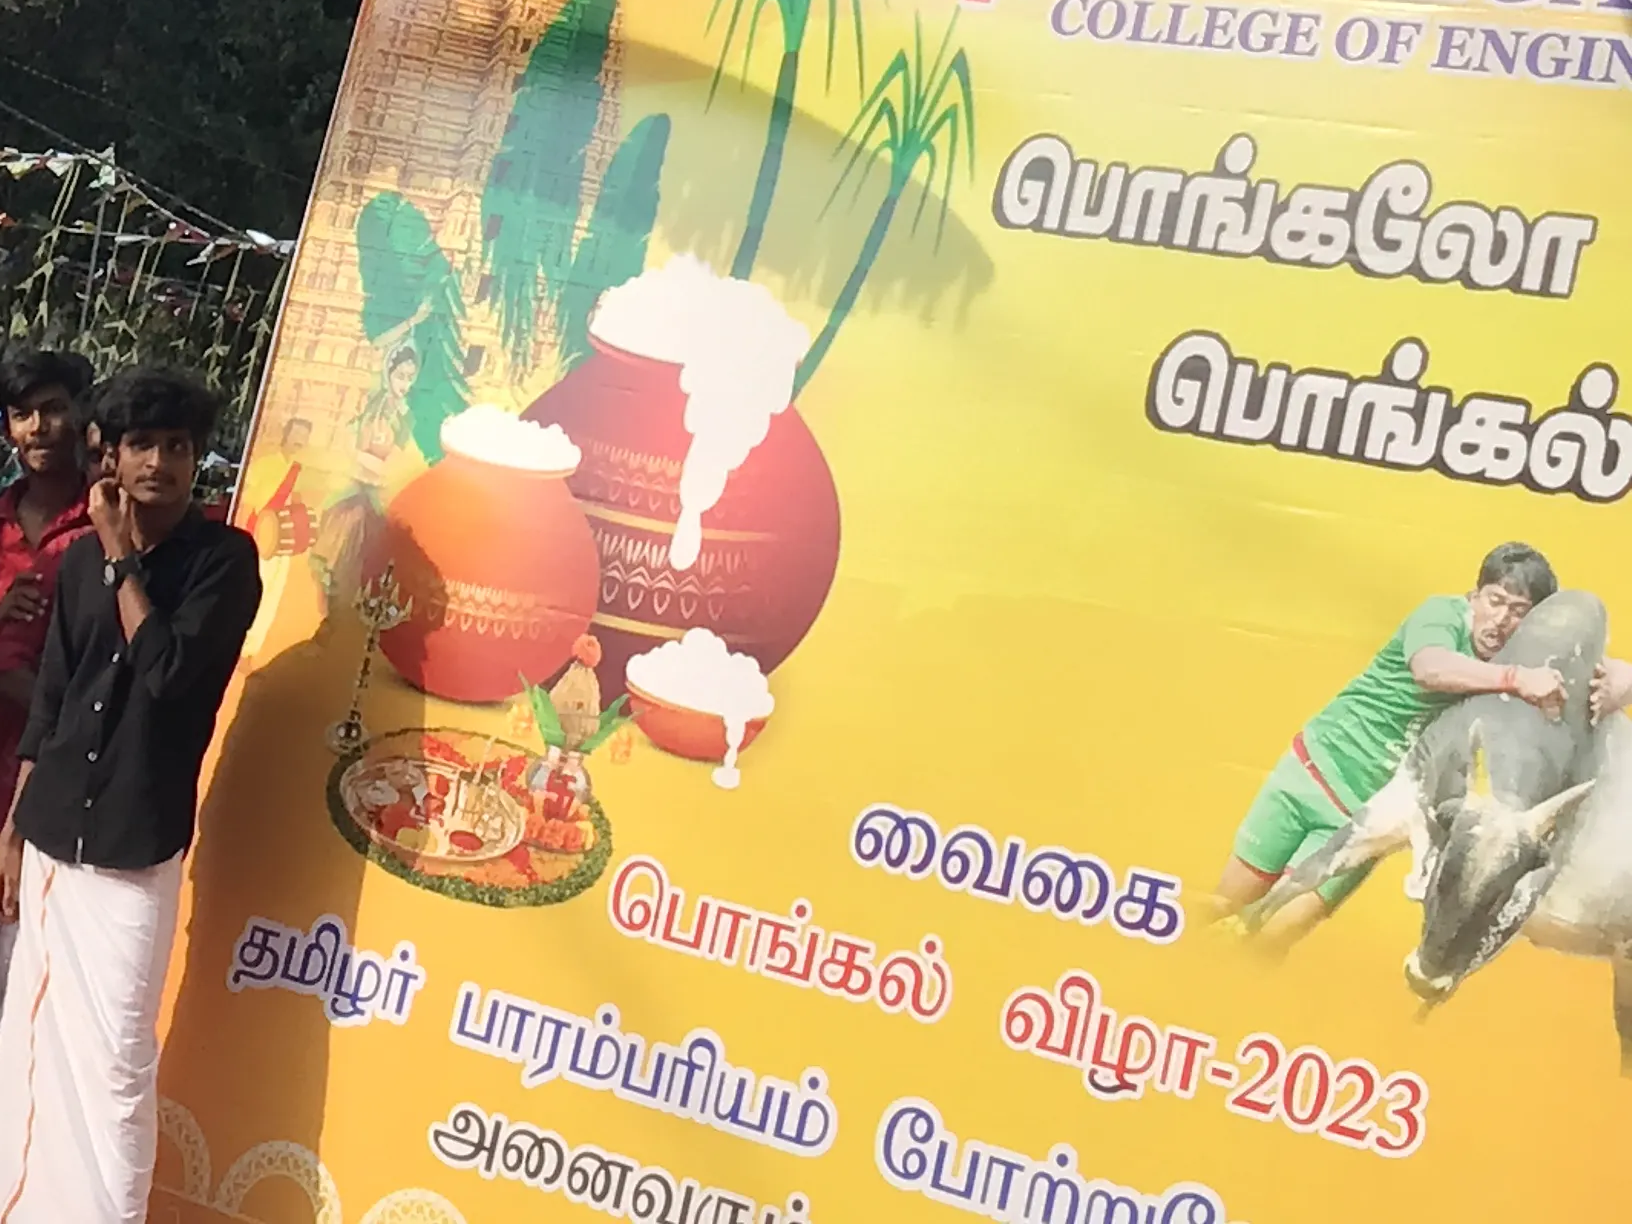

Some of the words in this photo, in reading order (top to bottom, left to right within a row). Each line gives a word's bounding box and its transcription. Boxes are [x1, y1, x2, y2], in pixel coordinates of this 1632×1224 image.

[1335, 17, 1422, 64] OF
[992, 132, 1598, 298] பொங்கலோ
[1145, 329, 1632, 503] பொங்கல்
[854, 808, 1180, 938] வைகை
[232, 922, 418, 1018] தமிழர்
[456, 990, 831, 1149] பாரம்பரியம்
[611, 860, 949, 1018] பொங்கல்
[1004, 976, 1424, 1152] விழா-2023
